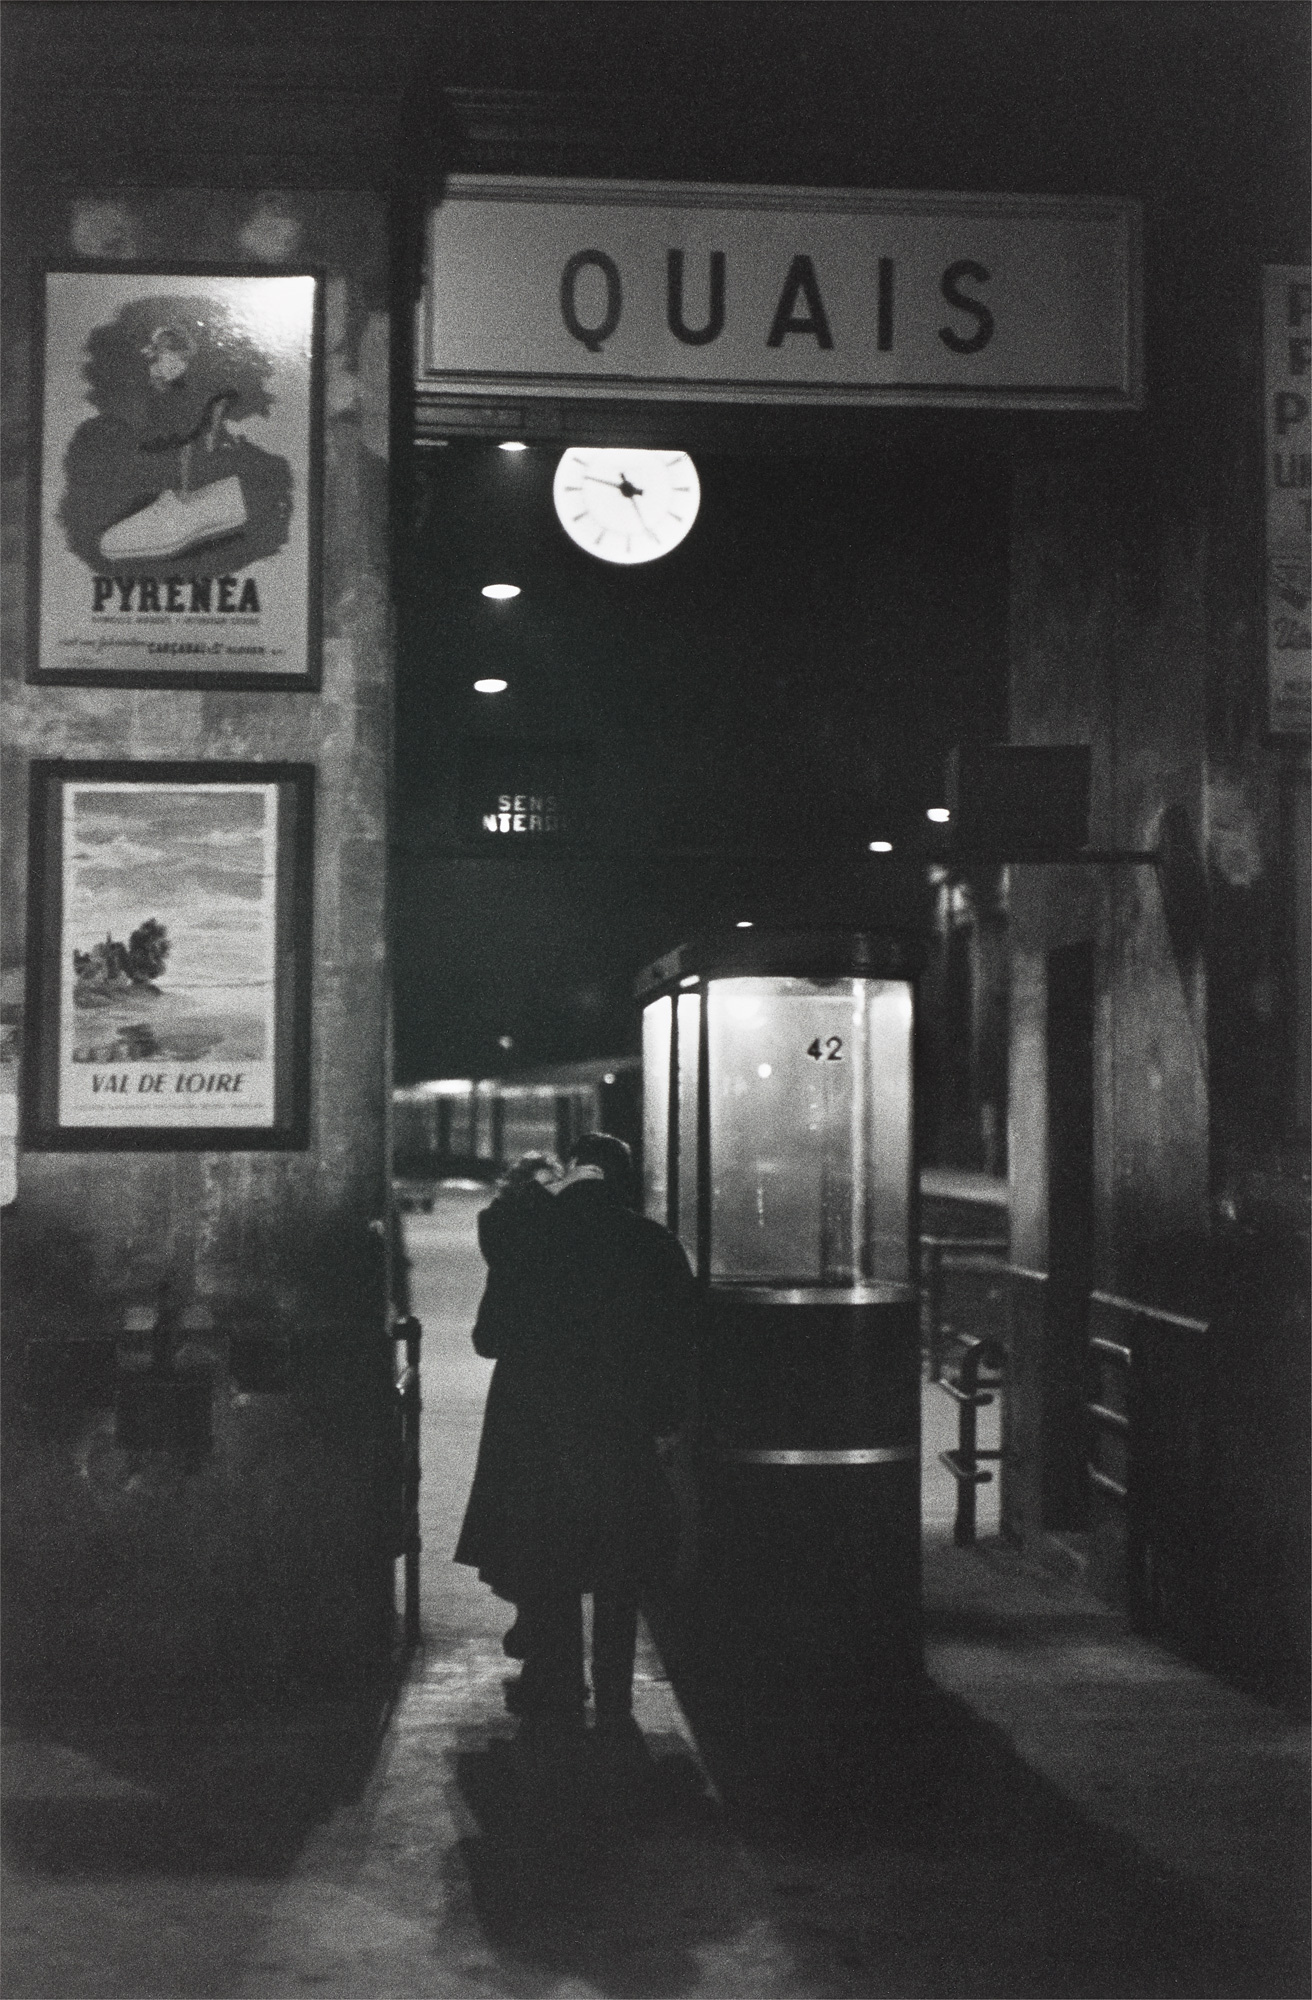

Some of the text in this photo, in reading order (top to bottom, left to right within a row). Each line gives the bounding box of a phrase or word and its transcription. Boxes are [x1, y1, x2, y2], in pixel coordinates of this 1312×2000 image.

[559, 248, 995, 354] QUAIS
[807, 1036, 843, 1061] 42
[92, 1072, 246, 1093] VAL DE LOIRE
